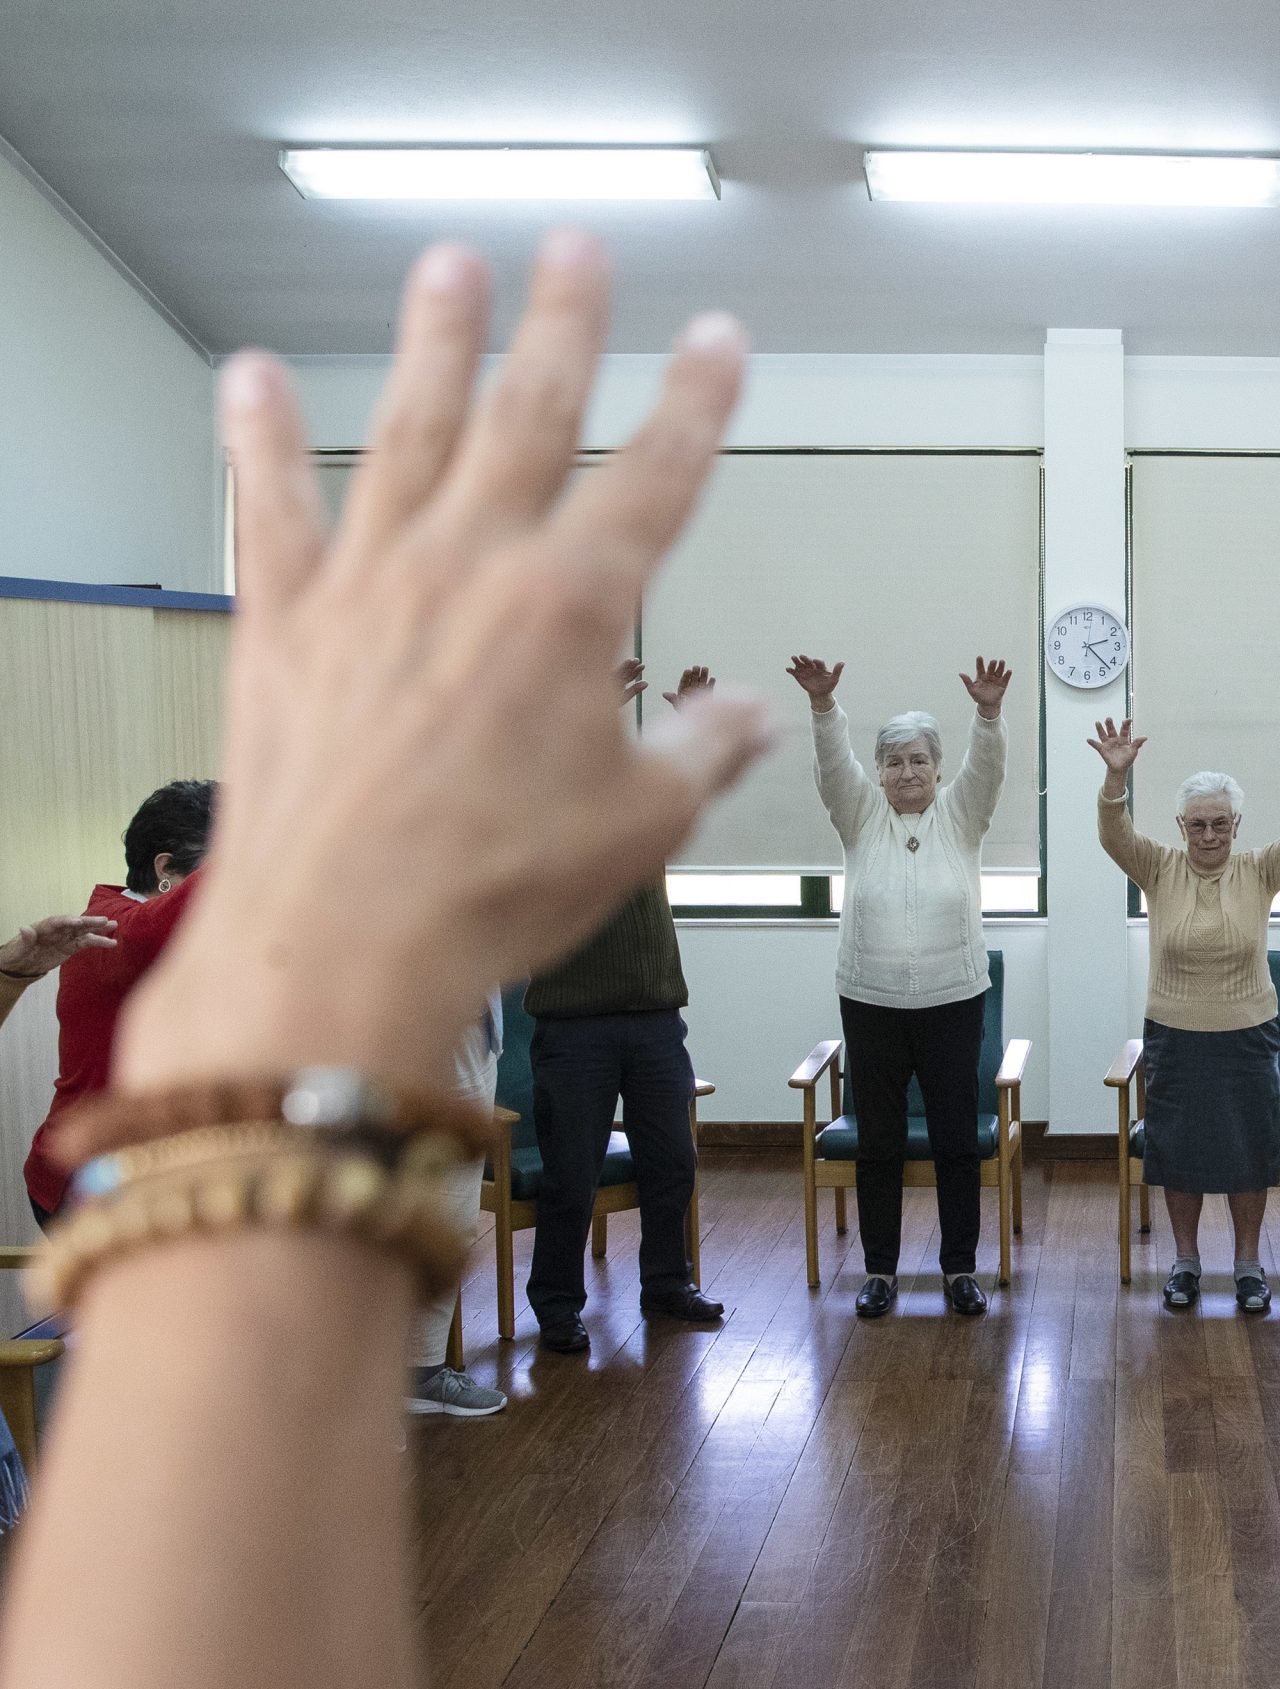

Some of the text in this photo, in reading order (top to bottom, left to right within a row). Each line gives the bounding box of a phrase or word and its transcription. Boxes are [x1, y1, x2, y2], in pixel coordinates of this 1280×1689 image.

[1069, 616, 1078, 625] 11
[1083, 611, 1093, 621] 12
[1101, 616, 1105, 625] 1
[1057, 626, 1067, 636] 10
[1110, 627, 1117, 637] 2
[1054, 640, 1061, 650] 9
[1114, 641, 1121, 651] 3
[1058, 656, 1065, 665] 8
[1109, 656, 1117, 666] 4
[1068, 666, 1076, 676] 7
[1084, 670, 1091, 680] 6
[1099, 667, 1106, 677] 5
